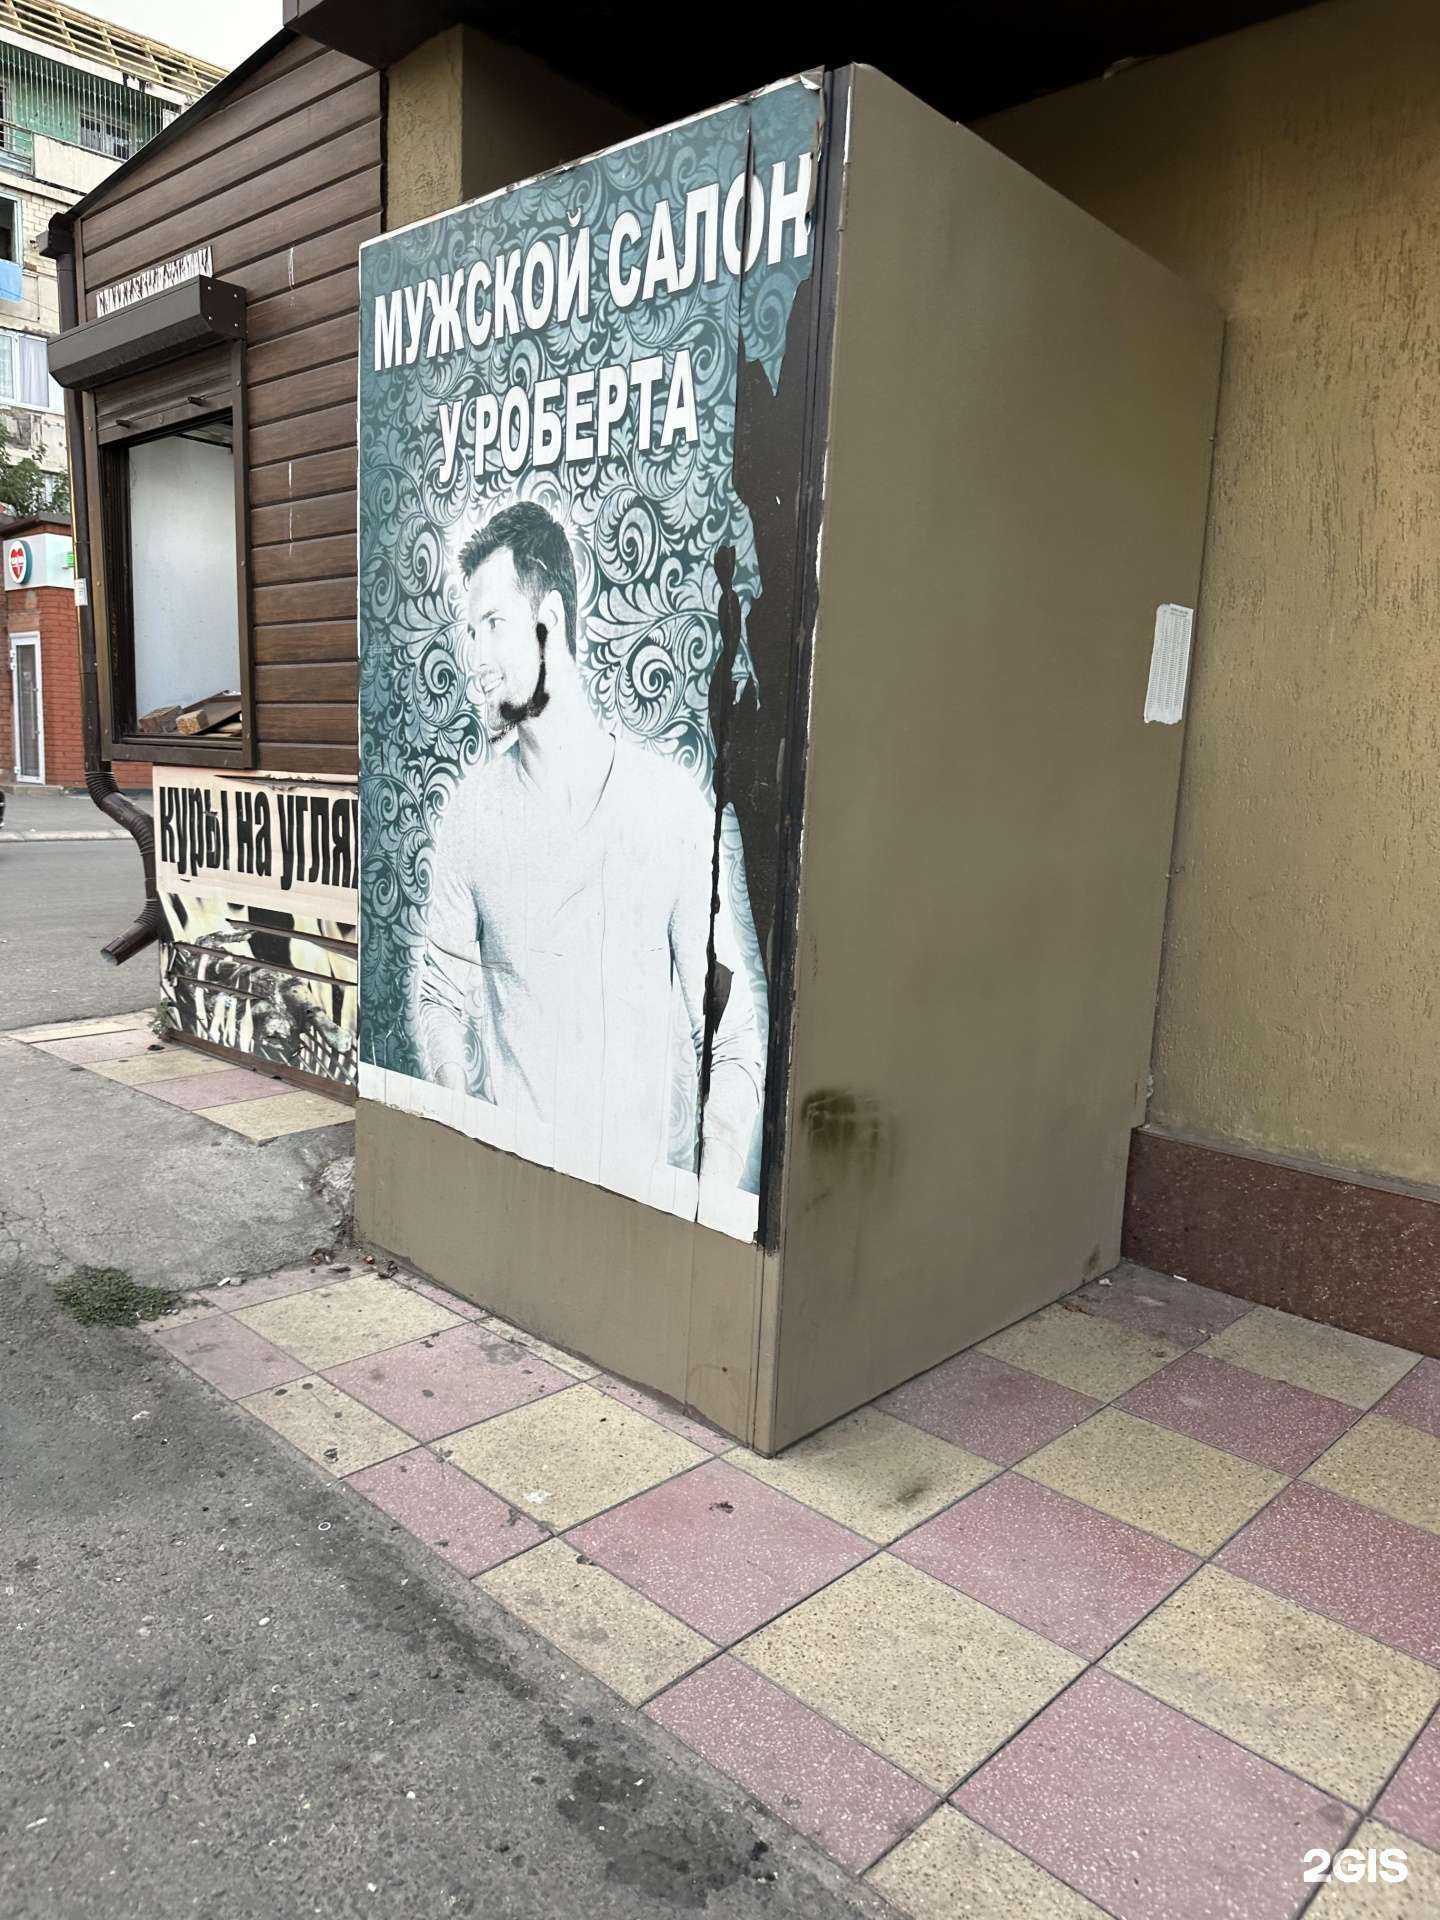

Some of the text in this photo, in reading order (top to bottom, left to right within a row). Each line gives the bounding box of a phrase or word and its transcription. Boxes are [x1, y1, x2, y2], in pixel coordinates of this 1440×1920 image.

[373, 206, 591, 373] МУЖСКОЙ
[607, 151, 813, 309] САЛОН
[438, 348, 701, 484] У РОБЕРТА
[159, 786, 231, 877] куры
[235, 790, 272, 877] на
